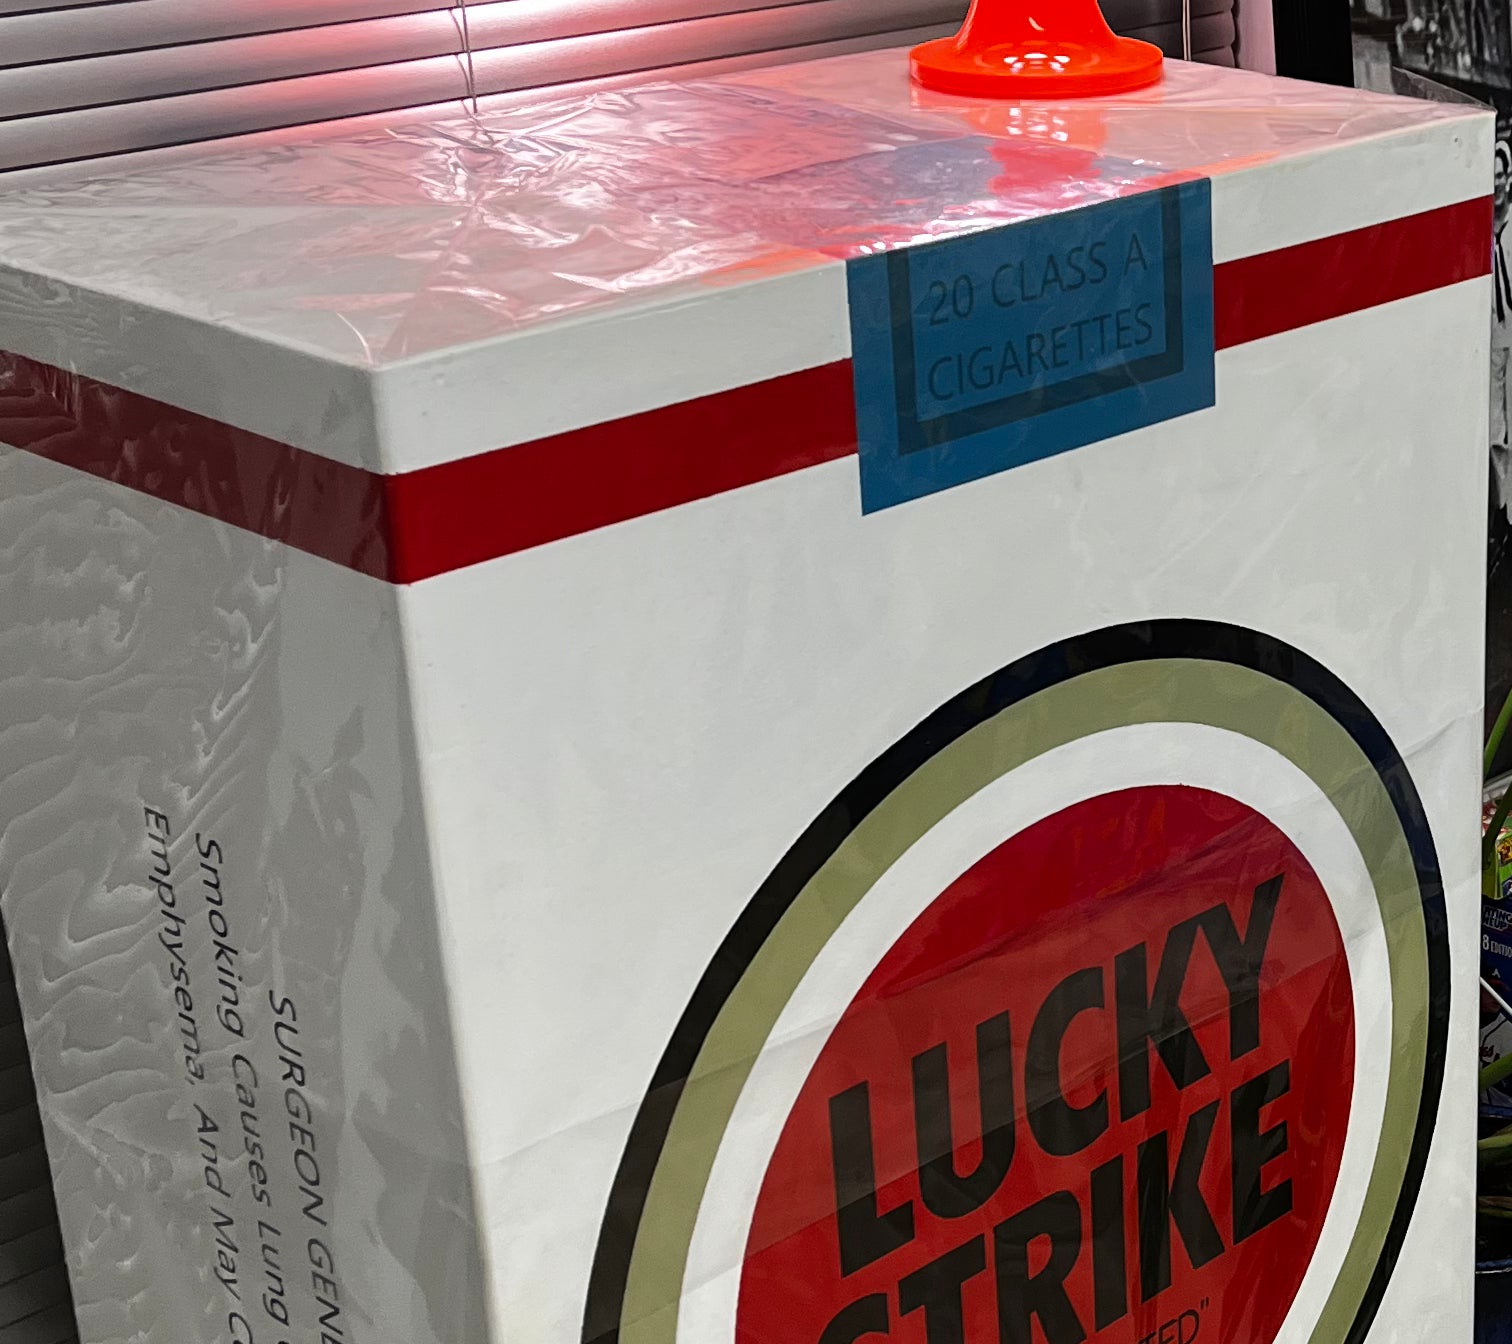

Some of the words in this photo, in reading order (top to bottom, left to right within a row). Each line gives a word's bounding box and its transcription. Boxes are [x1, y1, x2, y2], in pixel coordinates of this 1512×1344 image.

[927, 278, 974, 327] 20
[991, 242, 1108, 308] CLASS
[1117, 232, 1148, 274] A
[927, 304, 1153, 404] CIGARETTES
[144, 805, 206, 1086] Emphysema,
[194, 1102, 231, 1198] And
[196, 832, 245, 1038] Smoking
[231, 1053, 272, 1208] Causes
[256, 1220, 290, 1327] Lung
[268, 989, 328, 1227] SURGEON
[827, 874, 1285, 1278] LUCKY
[209, 1205, 241, 1306] May
